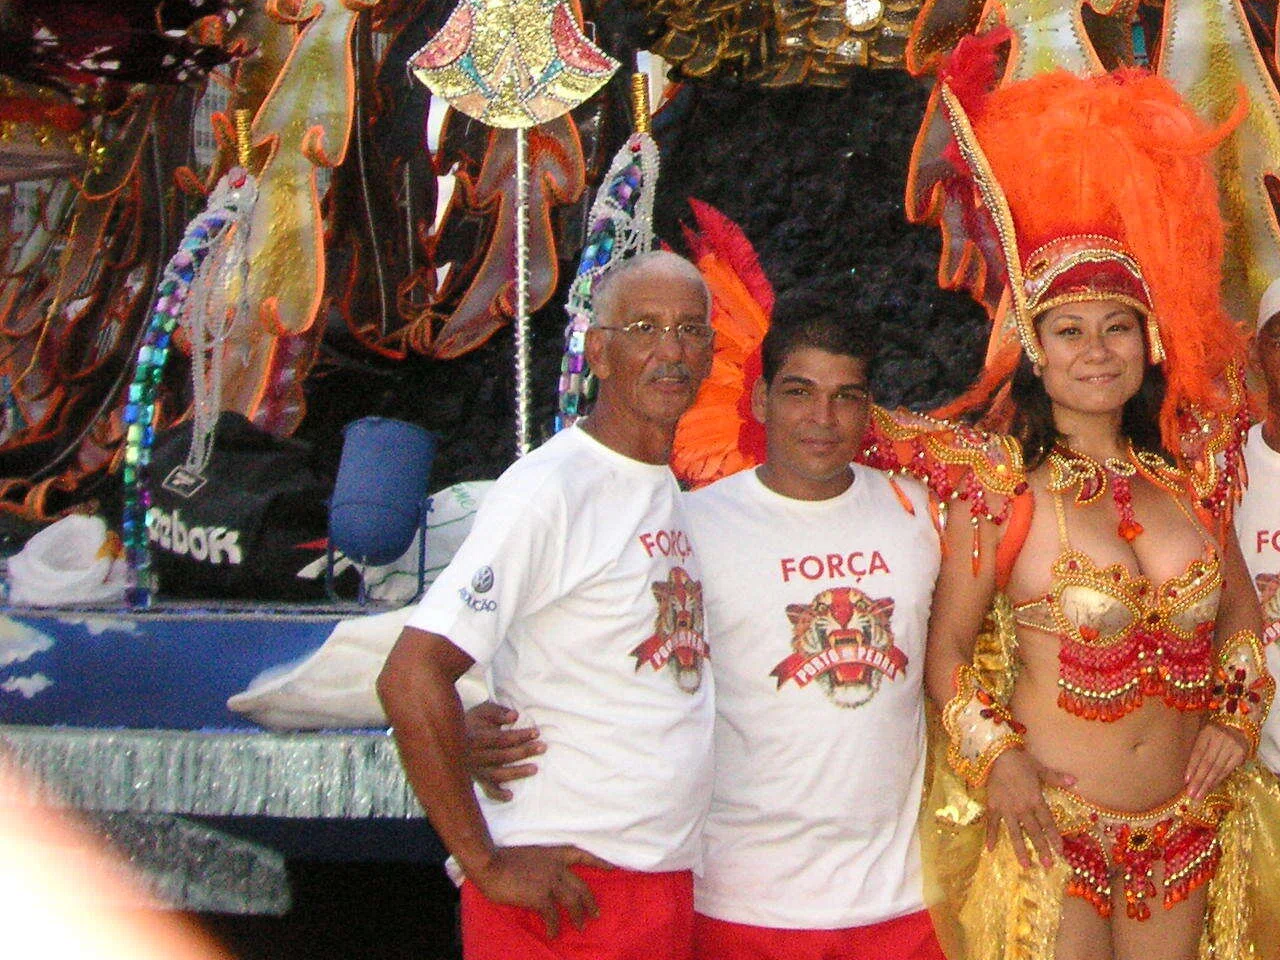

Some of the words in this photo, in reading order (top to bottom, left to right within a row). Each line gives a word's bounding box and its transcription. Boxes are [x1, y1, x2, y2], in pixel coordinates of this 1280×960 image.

[780, 550, 891, 583] FORÇA
[795, 648, 840, 682] PORTO
[857, 647, 897, 677] PEDRA
